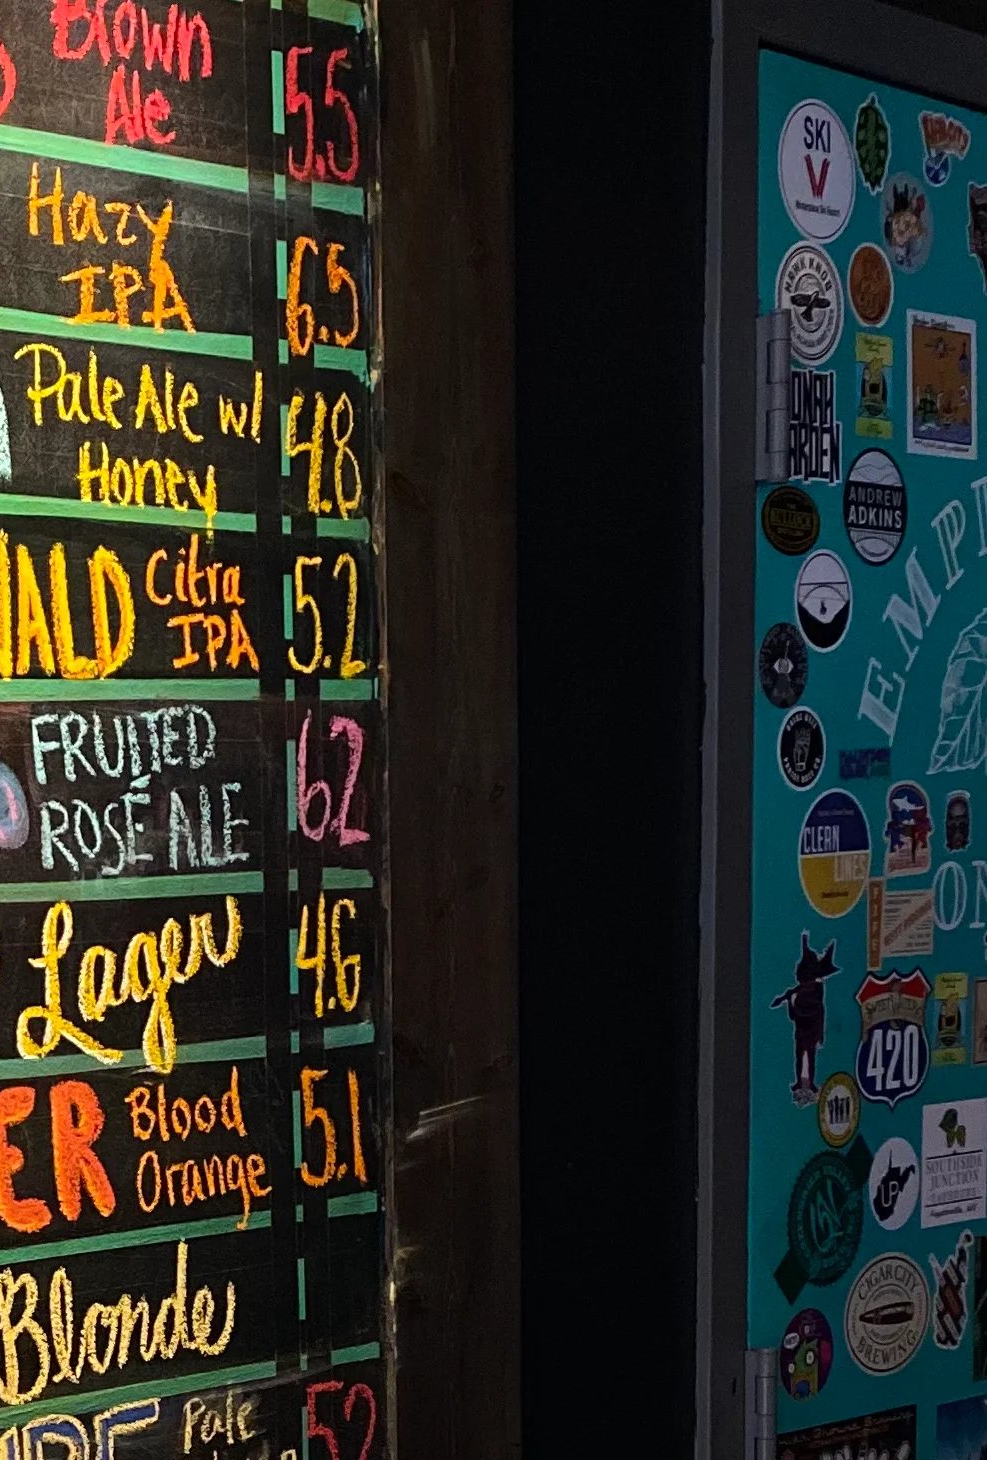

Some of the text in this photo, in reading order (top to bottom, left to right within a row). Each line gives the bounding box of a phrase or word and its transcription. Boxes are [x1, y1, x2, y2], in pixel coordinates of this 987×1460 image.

[105, 63, 176, 146] Ale
[283, 46, 361, 182] 5.5
[802, 115, 832, 154] SKI
[28, 161, 173, 264] Hazy
[59, 260, 196, 334] IPA
[285, 236, 361, 357] 6.5
[14, 343, 125, 430] Pale
[135, 362, 204, 443] Ale
[75, 440, 218, 541] Honey
[284, 391, 363, 521] 4.8
[847, 485, 904, 508] ANDREW
[847, 504, 903, 530] ADKINS
[145, 533, 246, 609] Citra
[167, 609, 261, 672] IPA
[290, 551, 369, 680] 5.2
[31, 703, 216, 785] FRUITED
[169, 782, 250, 871] ALE
[16, 895, 242, 1074] Lager
[295, 891, 361, 1018] 4.6
[865, 1023, 921, 1092] 420
[125, 1065, 247, 1141] Blood
[298, 1065, 368, 1188] 5.1
[135, 1149, 273, 1230] Orange
[182, 1389, 258, 1454] Pale
